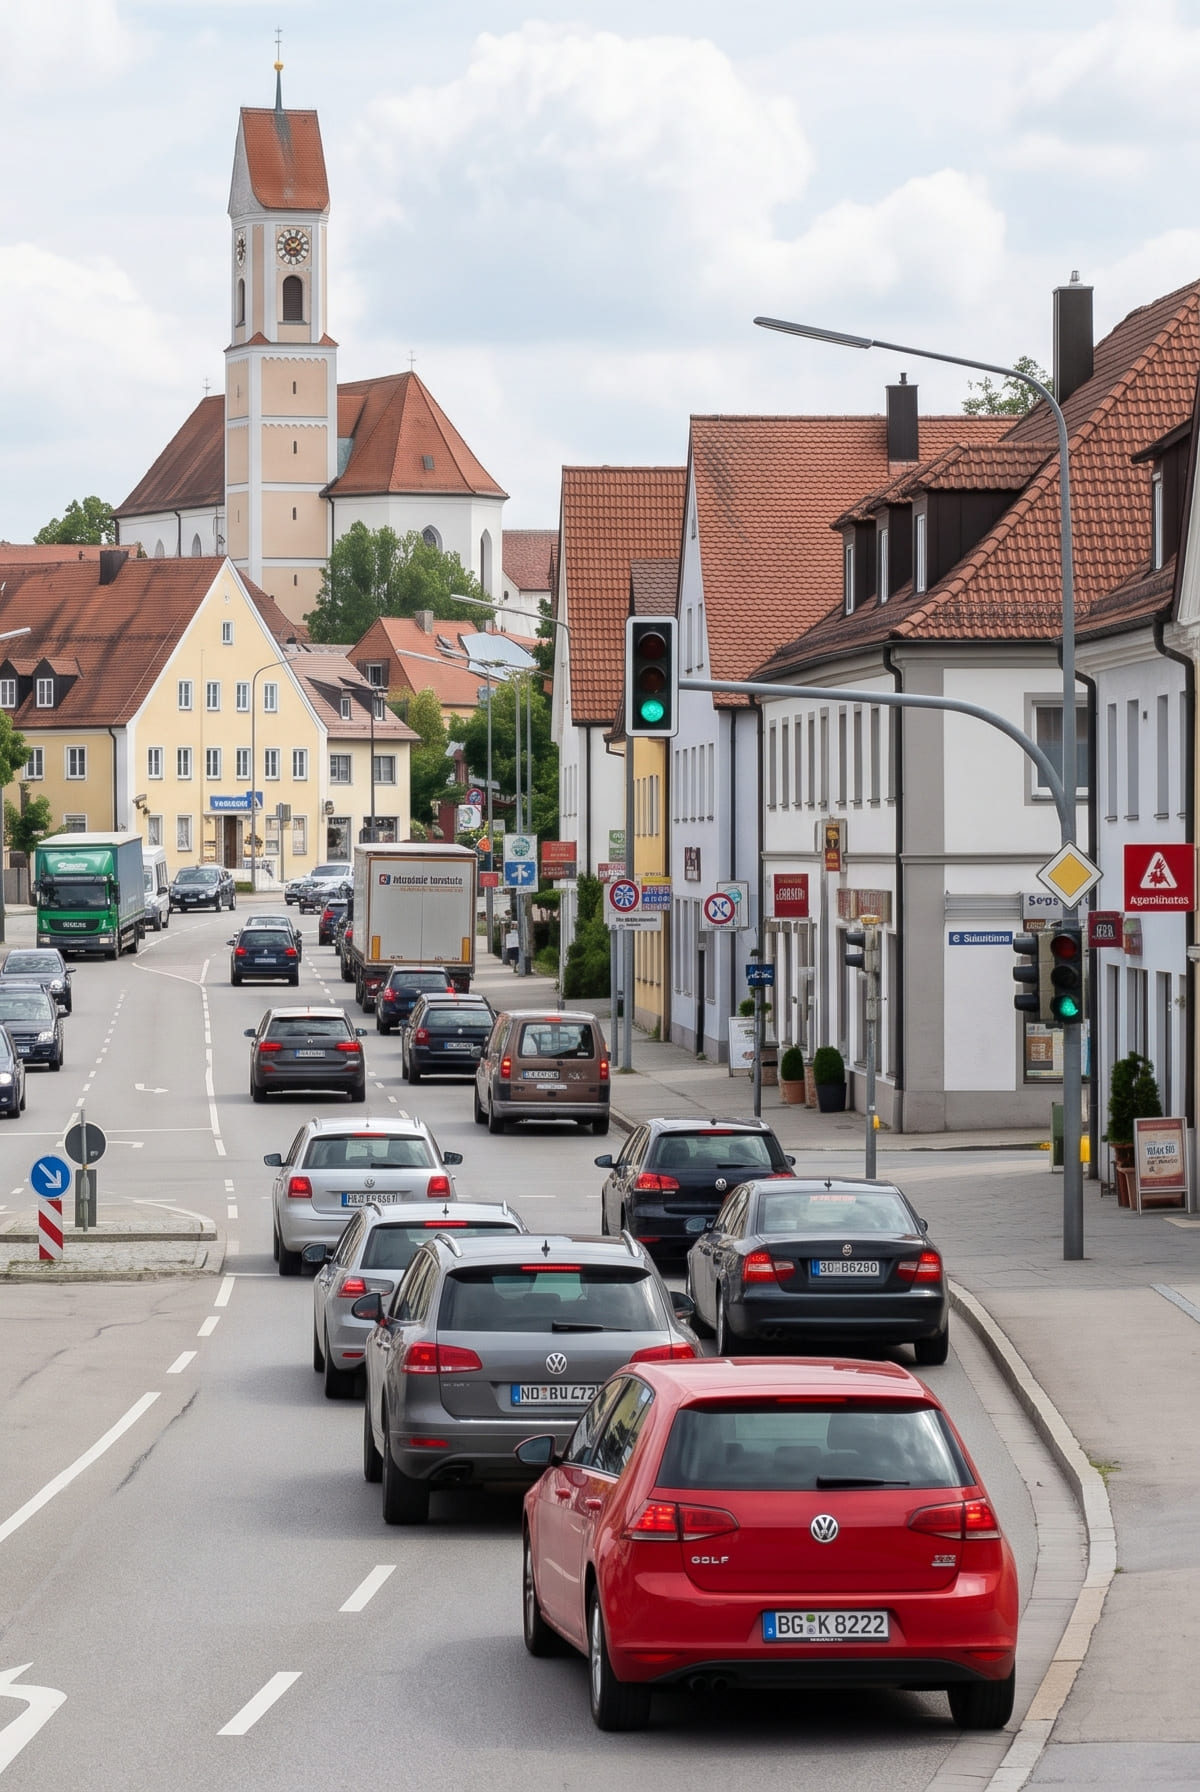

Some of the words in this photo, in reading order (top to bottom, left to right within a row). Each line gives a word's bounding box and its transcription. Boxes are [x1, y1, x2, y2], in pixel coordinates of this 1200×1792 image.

[521, 1386, 540, 1400] ND
[691, 1556, 729, 1564] GOLF
[777, 1615, 804, 1634] BG
[818, 1615, 831, 1634] K
[834, 1614, 885, 1634] 8222
